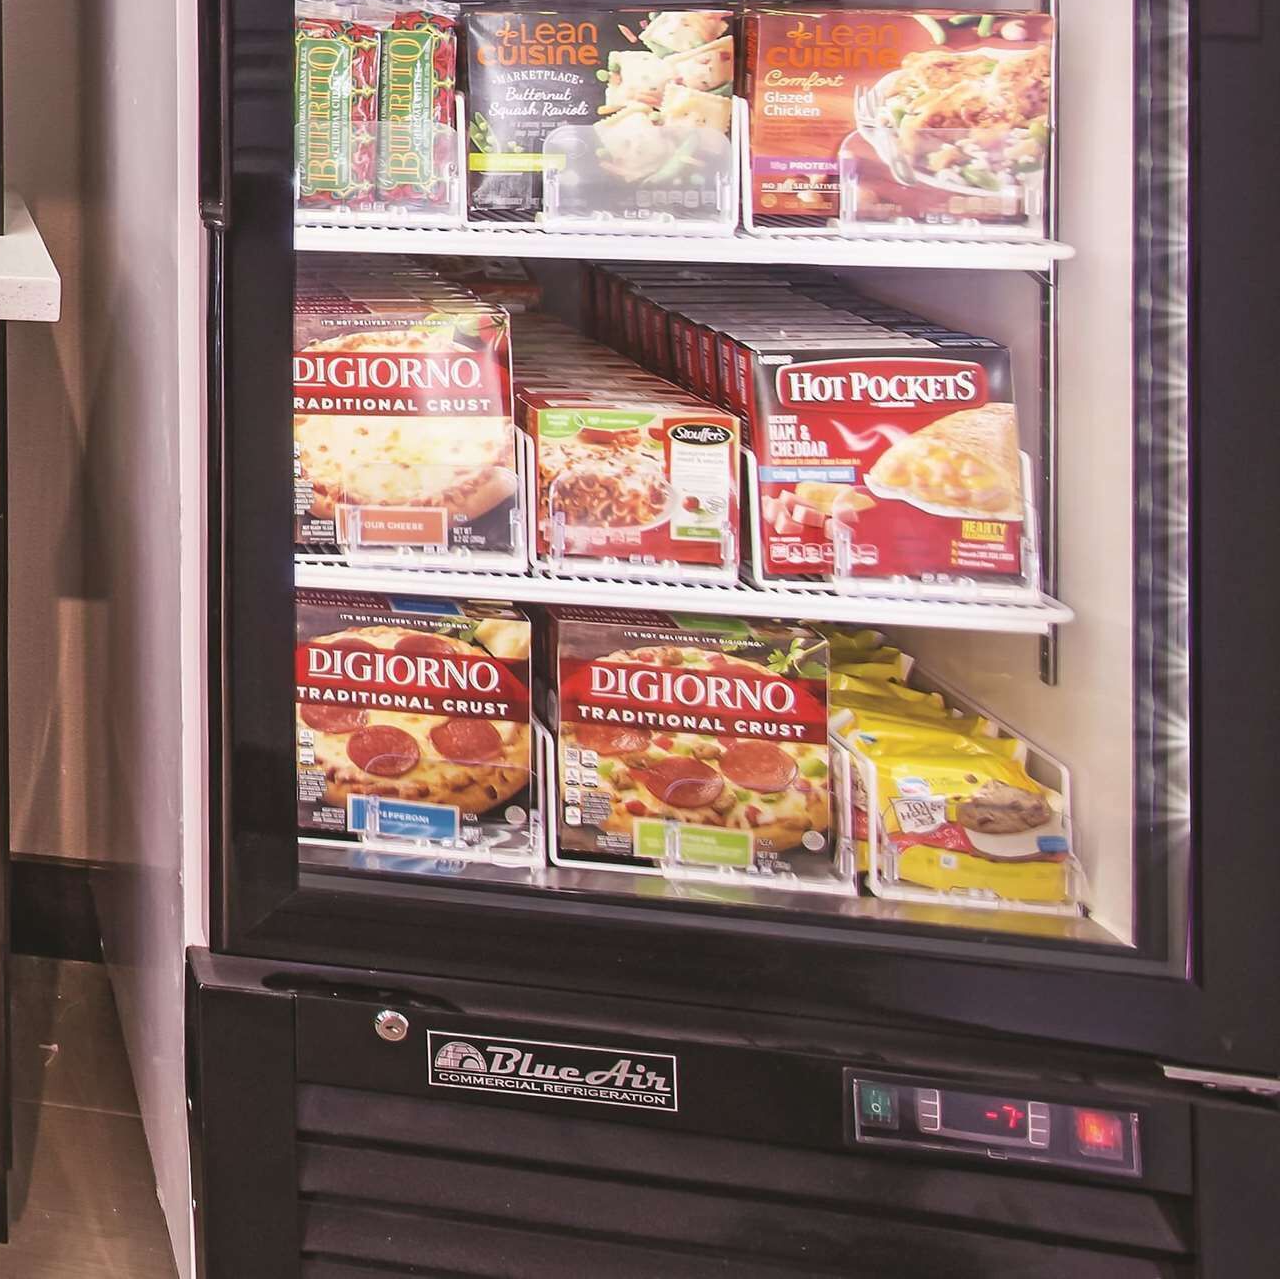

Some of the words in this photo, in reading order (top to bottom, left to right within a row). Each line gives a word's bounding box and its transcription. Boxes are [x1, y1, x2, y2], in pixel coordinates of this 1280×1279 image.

[520, 22, 599, 44] Lean
[815, 23, 900, 47] Lean
[497, 70, 581, 86] MARKETPLACE
[763, 69, 845, 90] Comfort
[504, 86, 572, 102] Butternut
[763, 91, 814, 105] Glazed
[307, 46, 341, 185] BURRITO
[389, 37, 422, 177] BURRITO
[487, 101, 539, 119] Squash
[541, 102, 589, 118] Ravioli
[763, 104, 821, 118] Chicken
[788, 160, 839, 171] PROTEIN
[788, 372, 847, 402] HOT
[848, 369, 977, 404] POCKETS
[426, 398, 492, 413] CRUST
[677, 424, 730, 444] Stouffer's
[768, 424, 798, 441] HAM
[800, 425, 811, 440] &
[769, 440, 828, 458] CHEDDAR
[961, 520, 1008, 536] HEARTY
[296, 685, 435, 711] TRADITIONAL
[442, 698, 510, 717] CRUST
[577, 704, 726, 732] TRADITIONAL
[734, 718, 807, 739] CRUST
[438, 1071, 541, 1092] COMMERCIAL
[542, 1083, 667, 1105] REFRIGERATION
